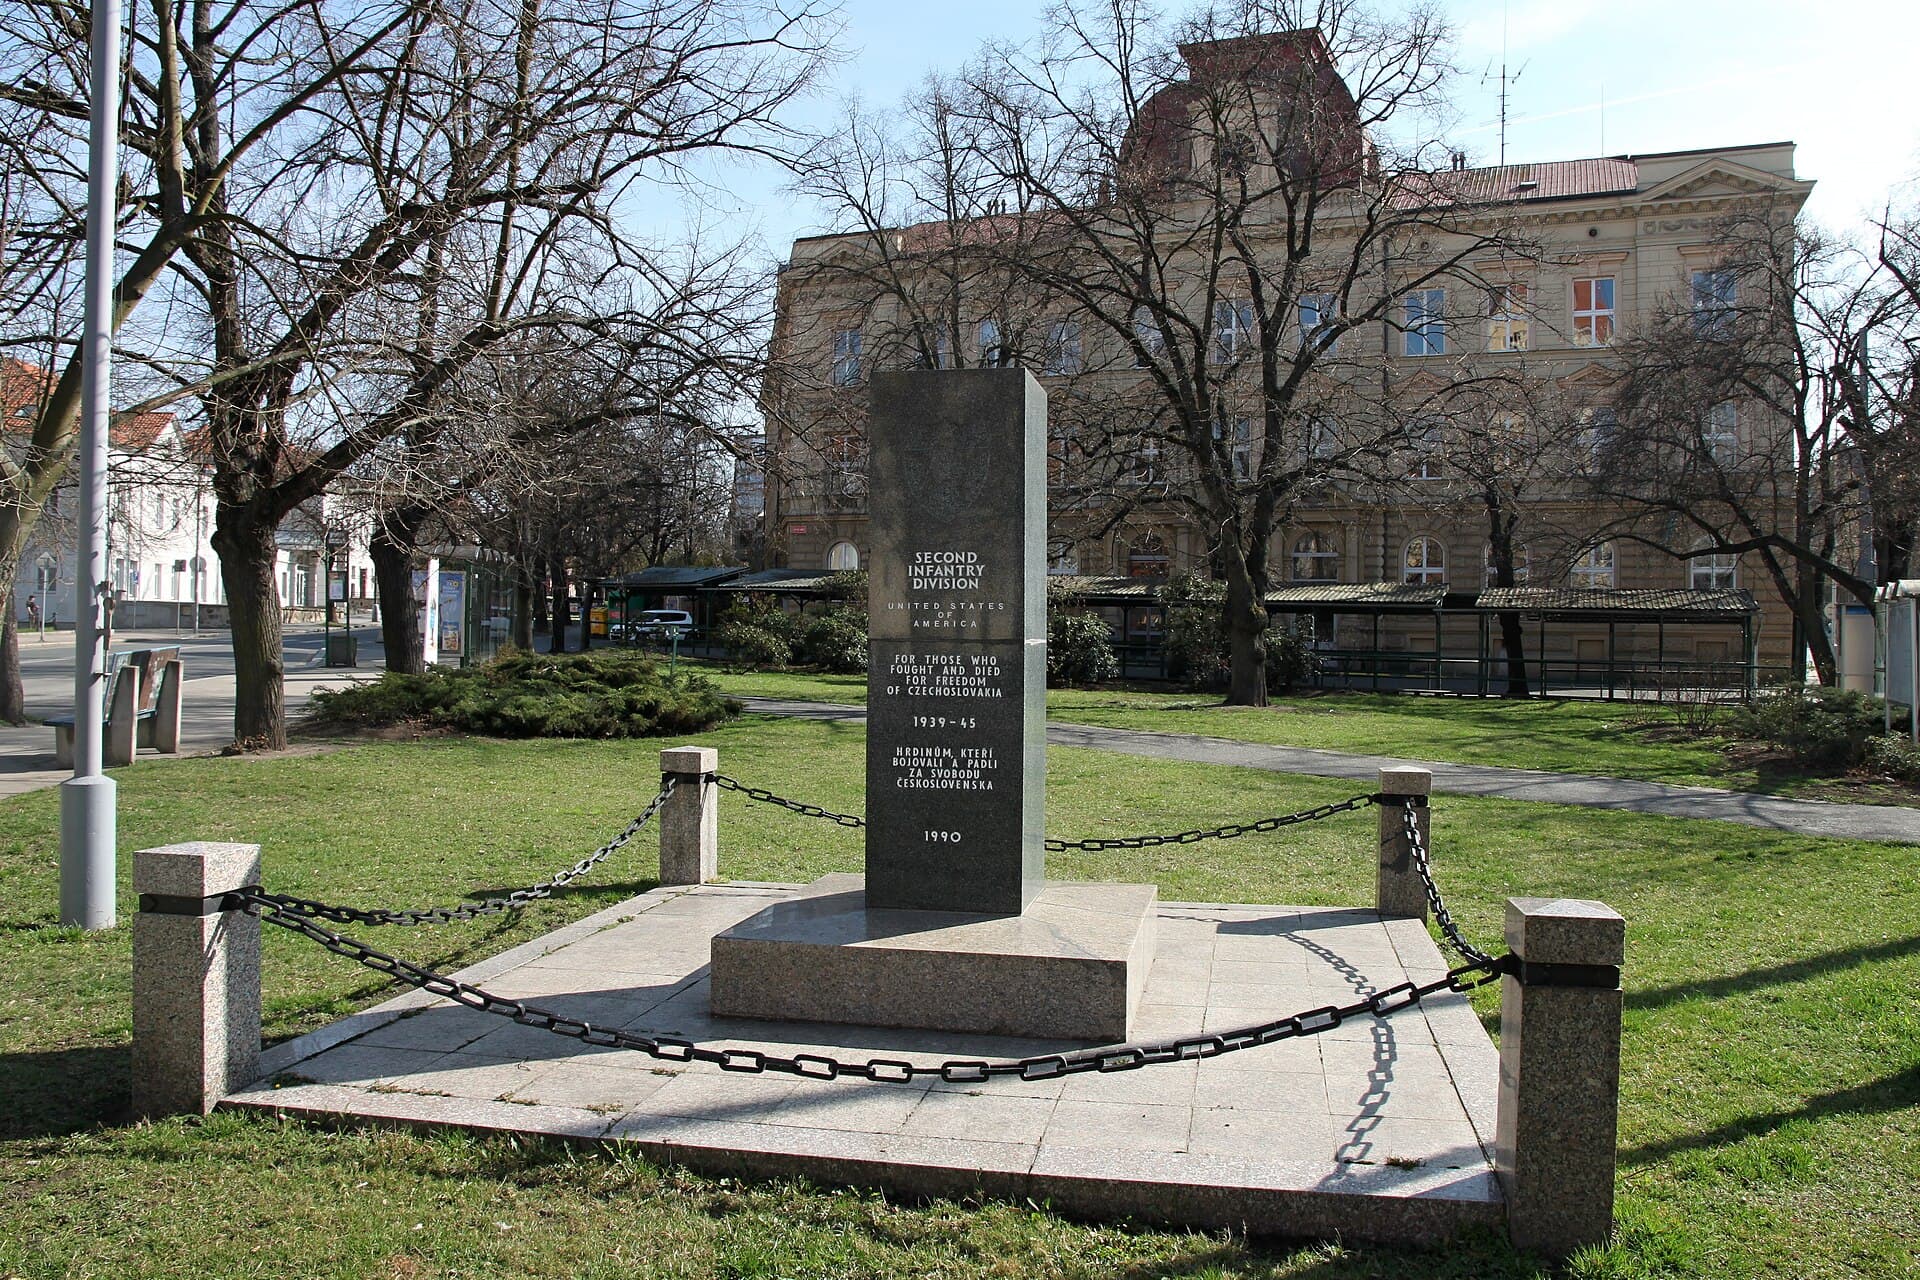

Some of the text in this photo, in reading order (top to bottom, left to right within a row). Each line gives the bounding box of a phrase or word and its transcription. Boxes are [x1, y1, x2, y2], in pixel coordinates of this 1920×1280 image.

[915, 552, 978, 564] SECOND
[908, 564, 985, 577] INFANTRY
[913, 578, 979, 590] DIVISION
[888, 602, 1004, 610] UNITED STATES
[913, 620, 977, 628] AMERICA
[895, 654, 997, 666] FOR THOSE WHO
[890, 665, 1000, 676] FOUGHT AND DIED
[906, 675, 986, 687] FOR FREEDOM
[887, 685, 1002, 698] OF CZECHOSLOVAKIA
[892, 757, 997, 769] BOJOVALI A PADLI
[909, 768, 980, 779] ZA SVOBODU
[896, 777, 993, 790] ČESKOSLOVENSKA
[924, 830, 961, 843] 1990
